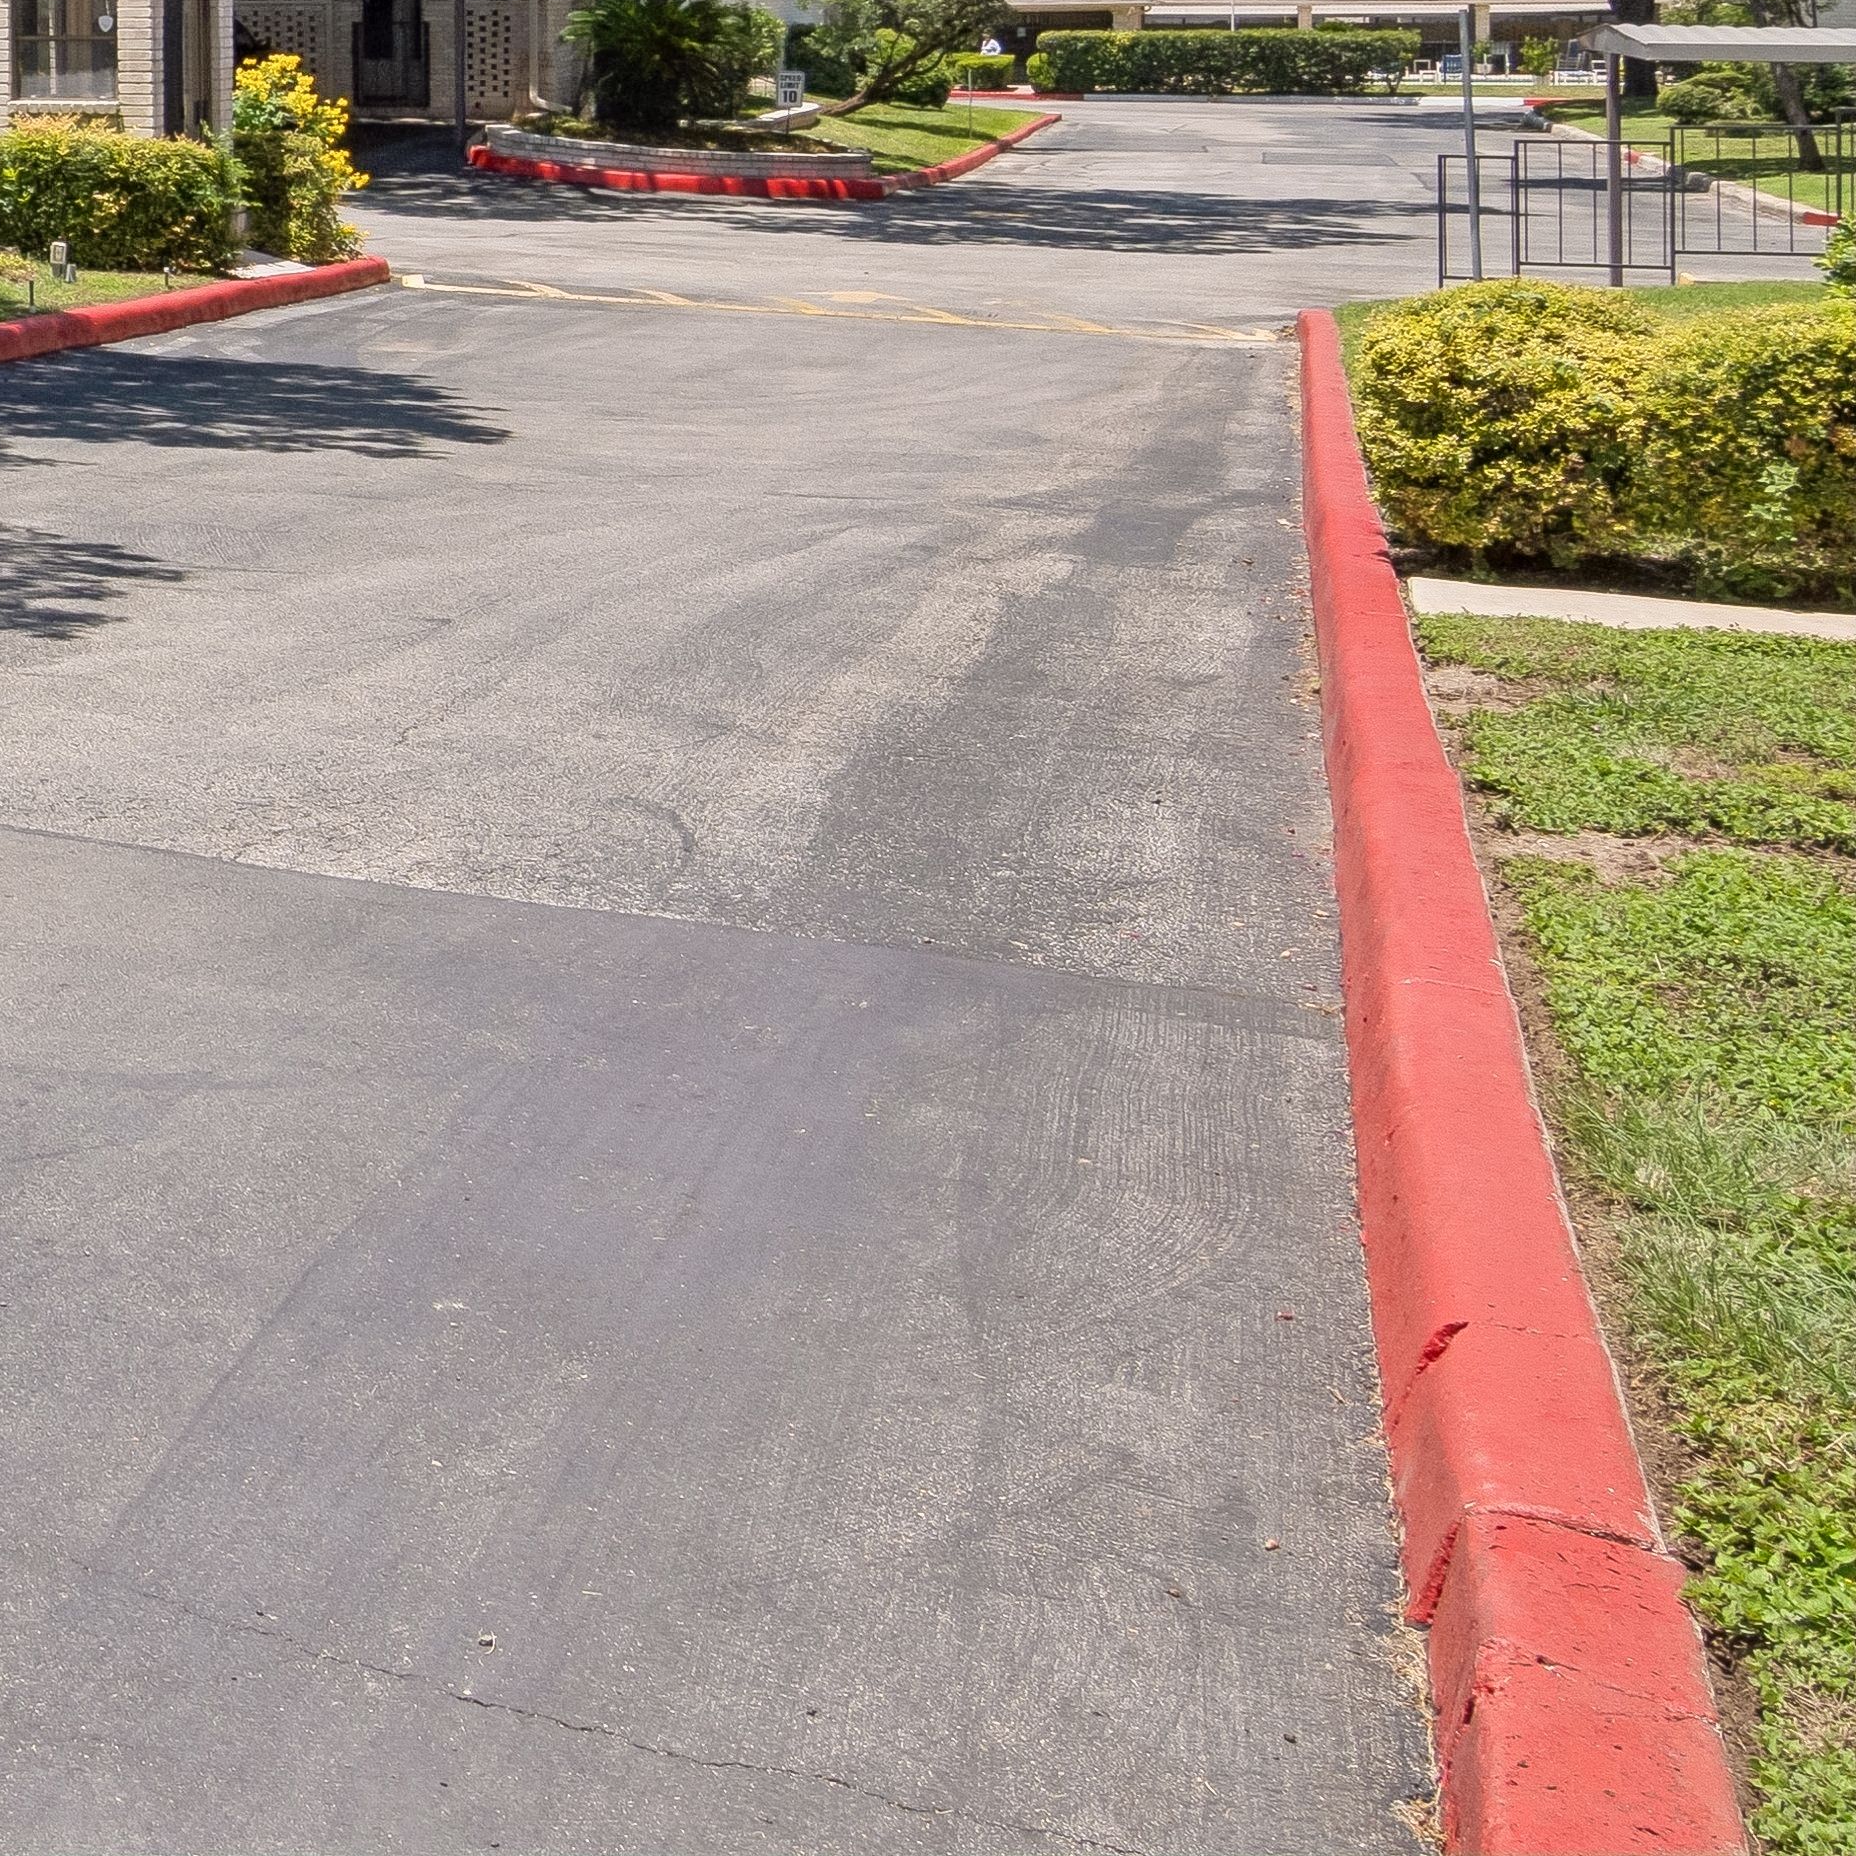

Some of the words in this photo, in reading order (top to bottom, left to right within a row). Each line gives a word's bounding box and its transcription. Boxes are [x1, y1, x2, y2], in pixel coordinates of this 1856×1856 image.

[779, 74, 802, 82] SPEED
[779, 82, 800, 90] LIMIT
[783, 90, 798, 104] 10
